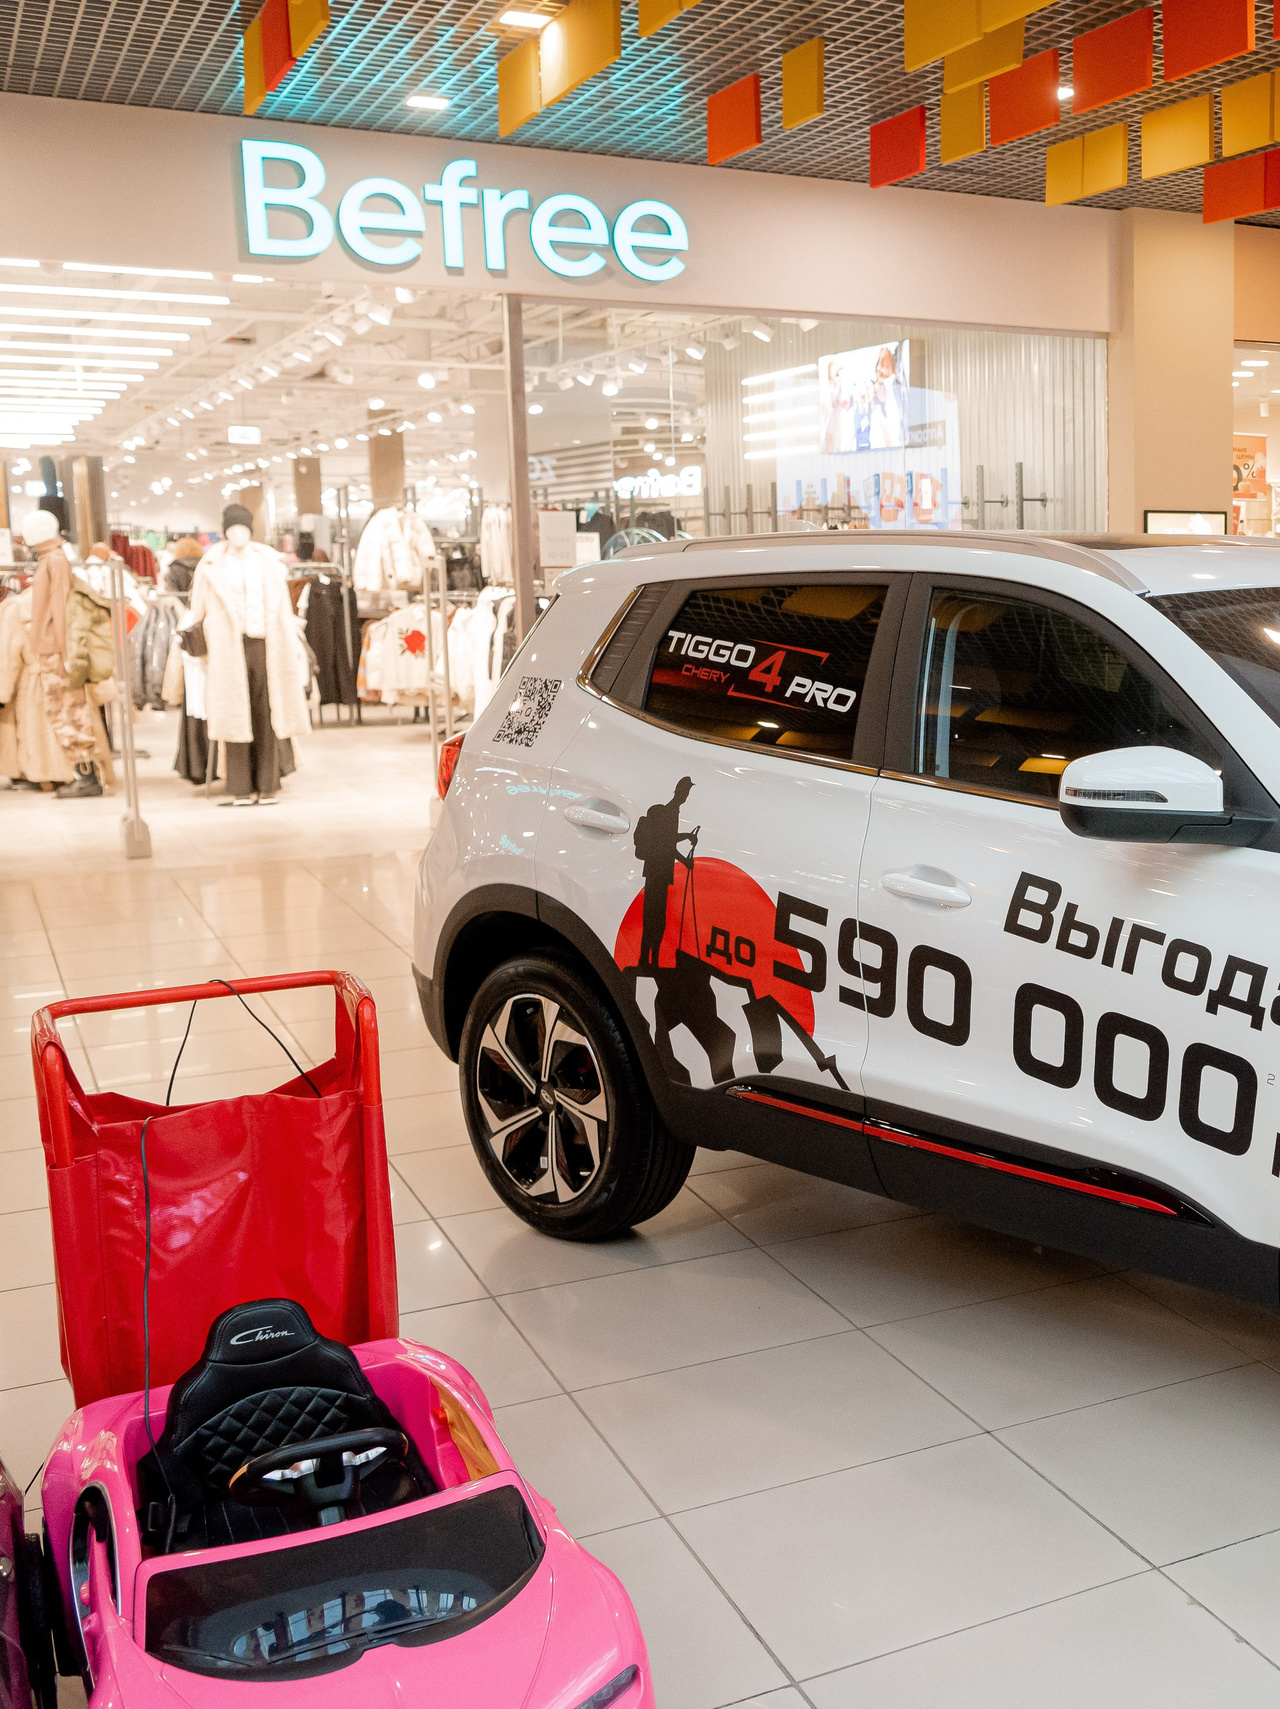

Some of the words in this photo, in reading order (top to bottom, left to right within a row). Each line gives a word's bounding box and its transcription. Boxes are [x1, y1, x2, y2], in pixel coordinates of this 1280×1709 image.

[240, 139, 690, 283] Befree
[667, 630, 756, 669] TIGGO
[747, 650, 784, 694] 4
[784, 677, 857, 714] PRO
[681, 663, 732, 685] CHERY
[705, 925, 756, 969] до
[772, 892, 973, 1048] 590
[1012, 982, 1260, 1157] 000
[229, 1325, 295, 1345] Chiron
